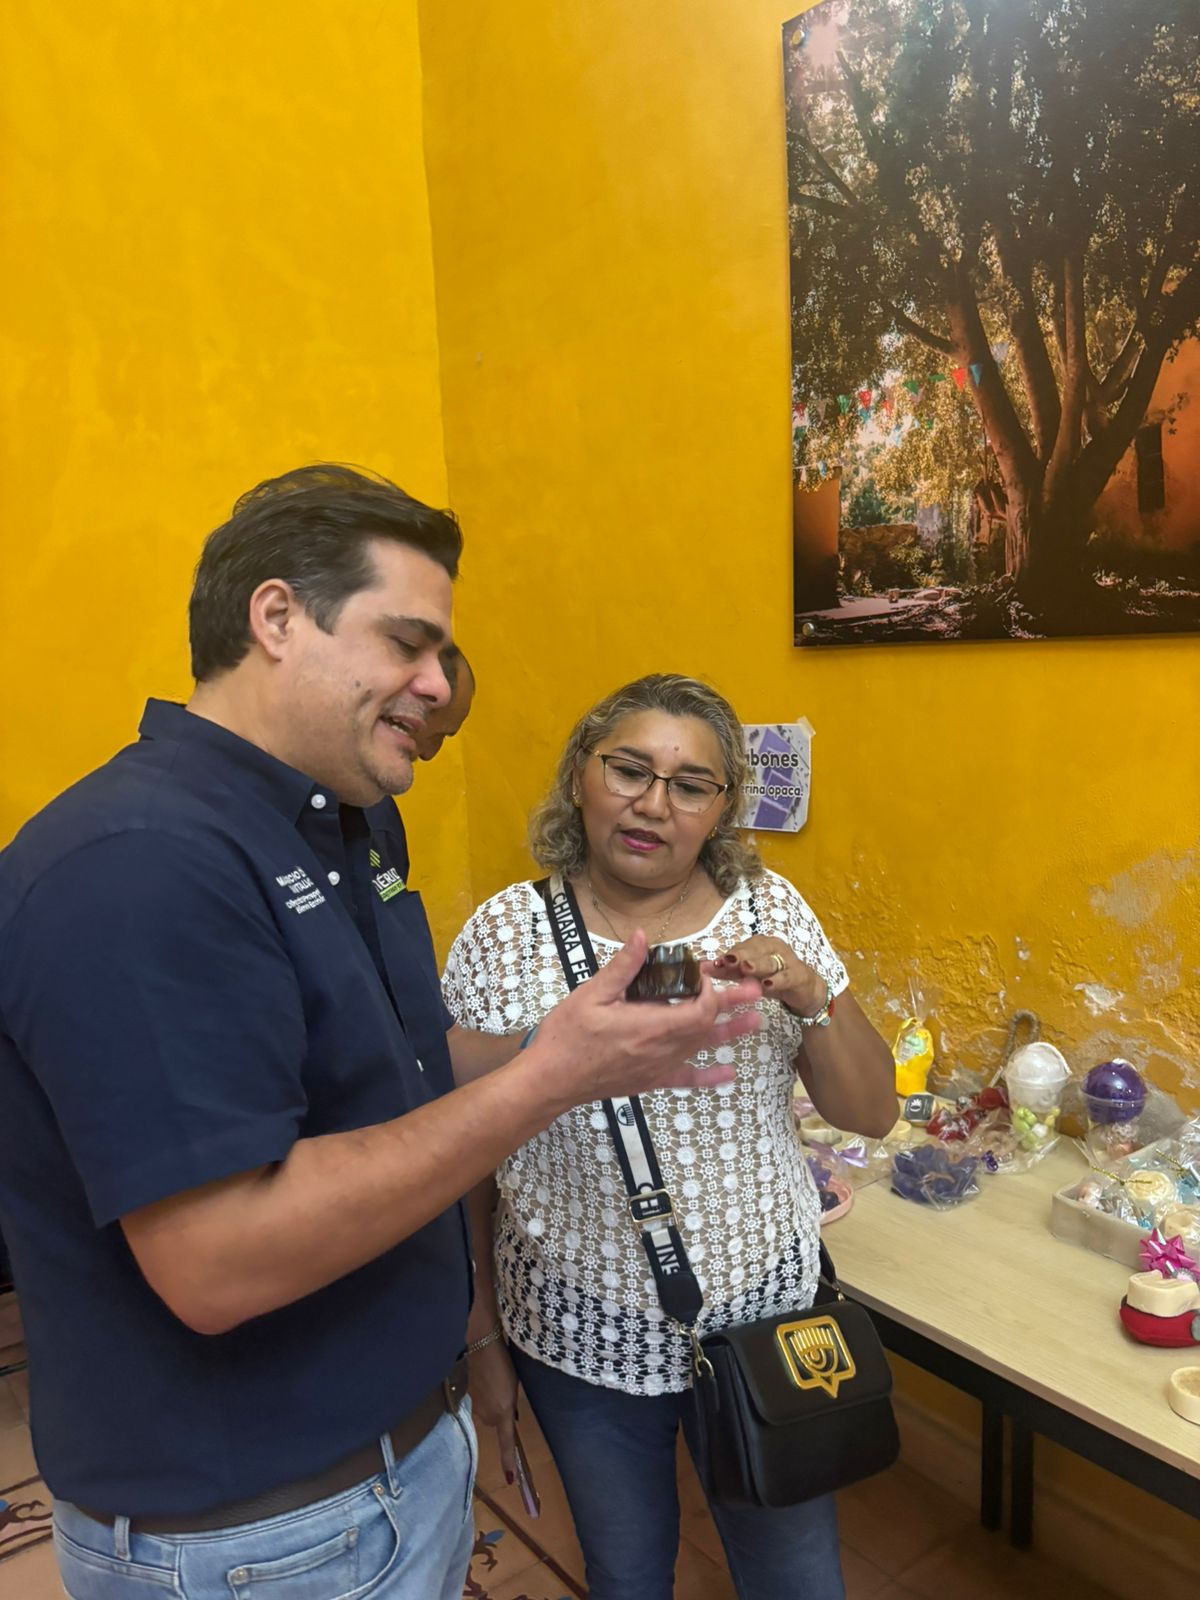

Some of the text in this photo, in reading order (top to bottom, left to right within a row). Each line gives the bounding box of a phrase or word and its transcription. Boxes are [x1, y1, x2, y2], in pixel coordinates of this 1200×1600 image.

[745, 748, 799, 767] bones
[768, 785, 804, 799] opaca.
[552, 892, 592, 986] CHIARA FE
